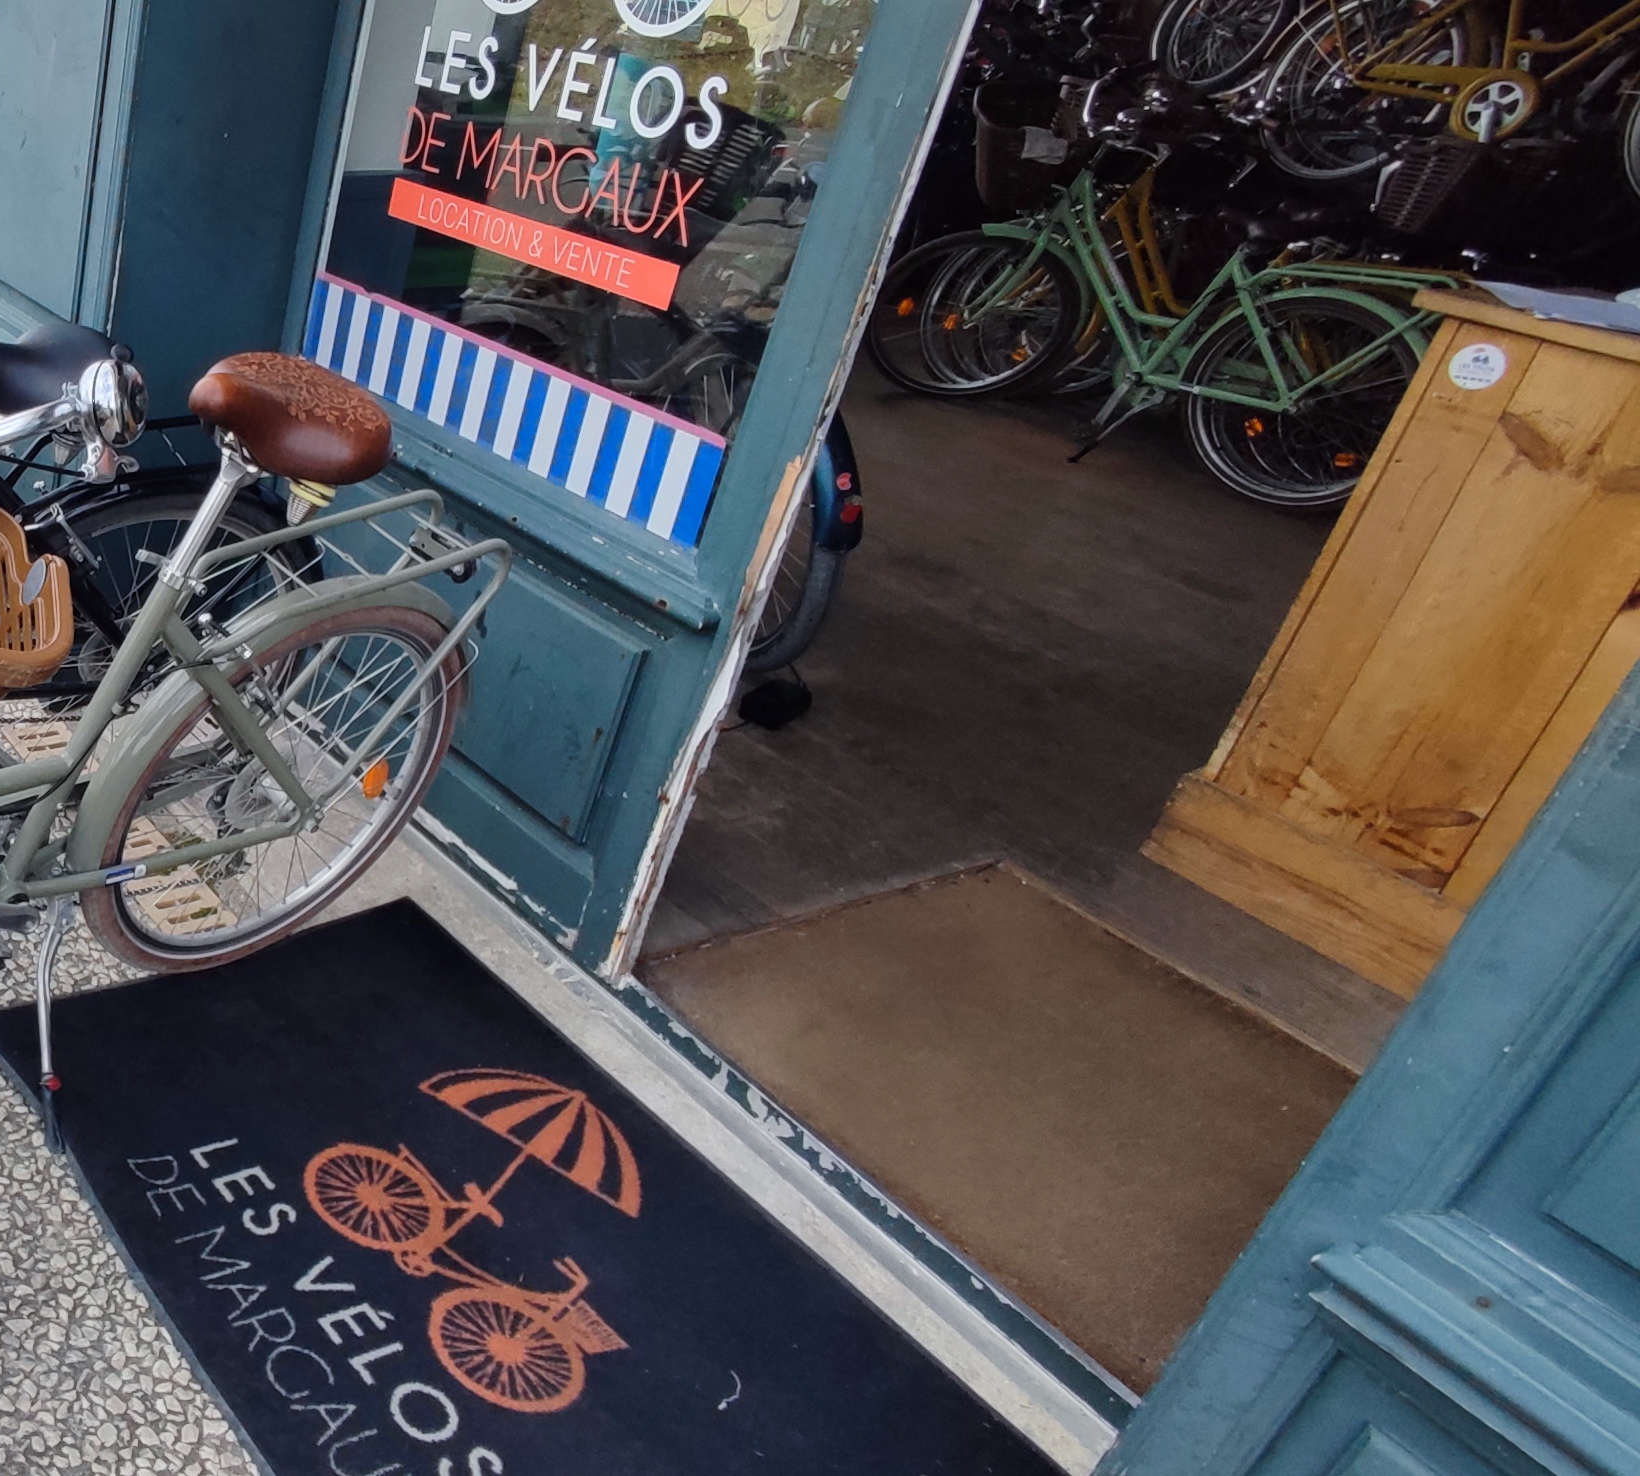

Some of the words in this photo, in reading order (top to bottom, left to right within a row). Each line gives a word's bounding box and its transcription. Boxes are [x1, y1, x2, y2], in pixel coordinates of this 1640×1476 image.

[414, 25, 499, 100] LES
[528, 37, 728, 150] VÉLOS
[398, 105, 452, 174] DE
[456, 119, 705, 248] MARGAUX
[417, 193, 524, 251] LOCATION
[528, 229, 544, 259] &
[553, 235, 637, 289] VENTE
[189, 1137, 297, 1236] LES
[127, 1155, 207, 1217] DE
[174, 1225, 412, 1476] MARGAU
